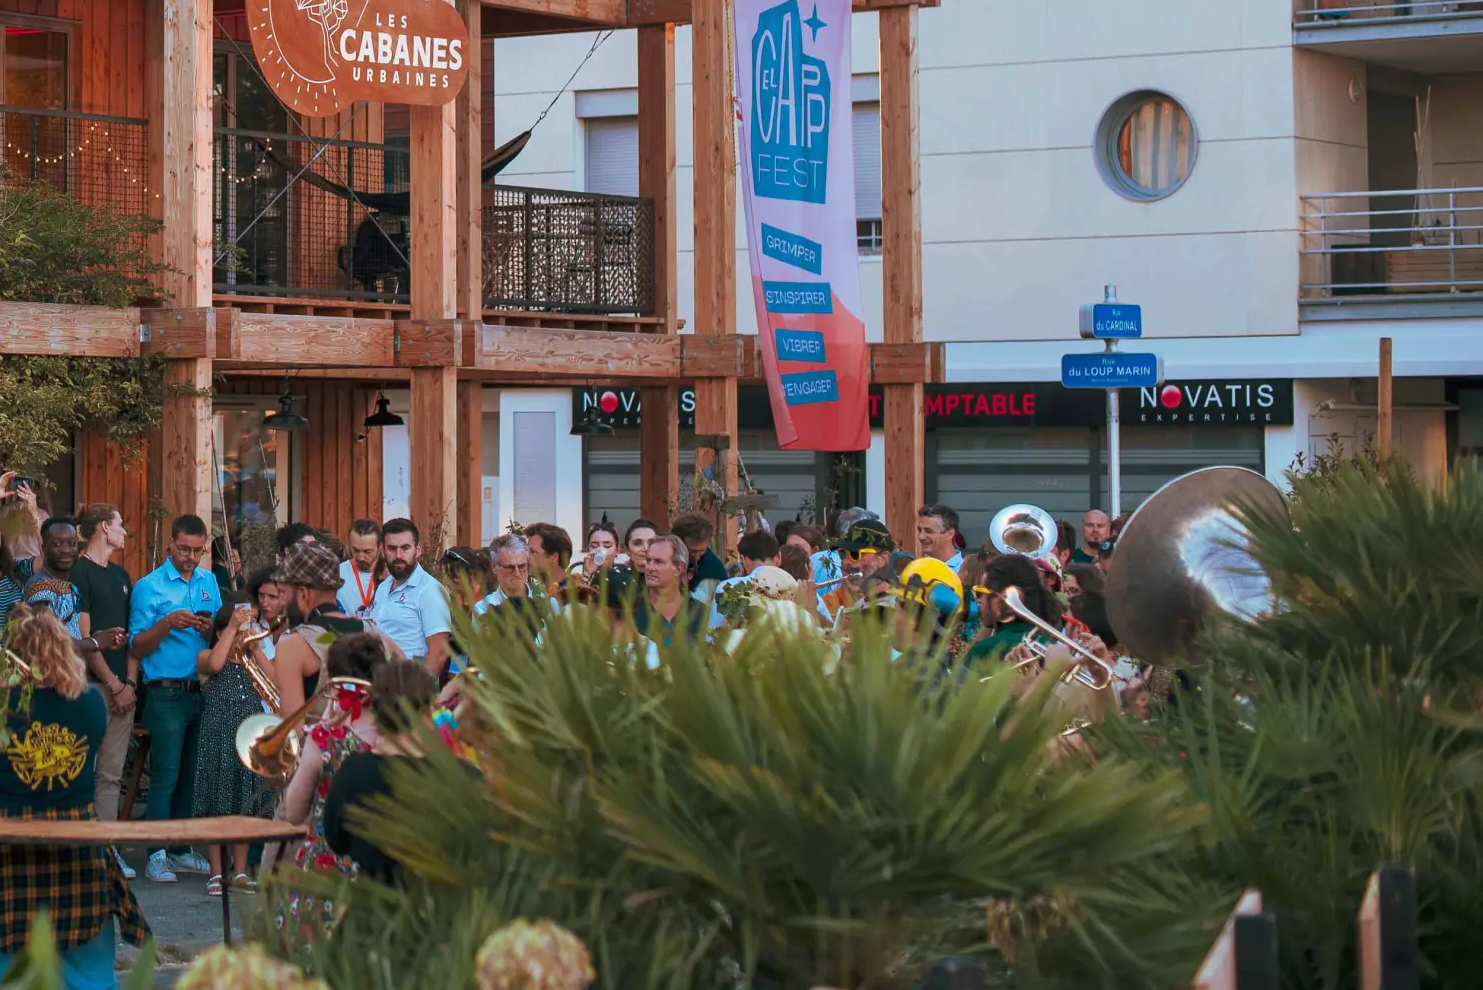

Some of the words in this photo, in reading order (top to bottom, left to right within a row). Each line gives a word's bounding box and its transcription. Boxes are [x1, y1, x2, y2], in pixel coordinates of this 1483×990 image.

[376, 12, 408, 29] LES
[340, 29, 462, 70] CABANES
[352, 67, 449, 88] URBAINES
[762, 67, 777, 90] EL
[758, 153, 823, 189] FEST
[767, 234, 816, 264] GRIMPER
[766, 290, 826, 305] S'INSPIRER
[1096, 321, 1104, 331] du
[1105, 320, 1138, 331] CARDINAL
[1068, 368, 1081, 377] du
[1084, 367, 1113, 376] LOUP
[1116, 366, 1151, 375] MARIN
[1140, 384, 1274, 409] NOVATIS
[1141, 413, 1271, 422] EXPERTISE
